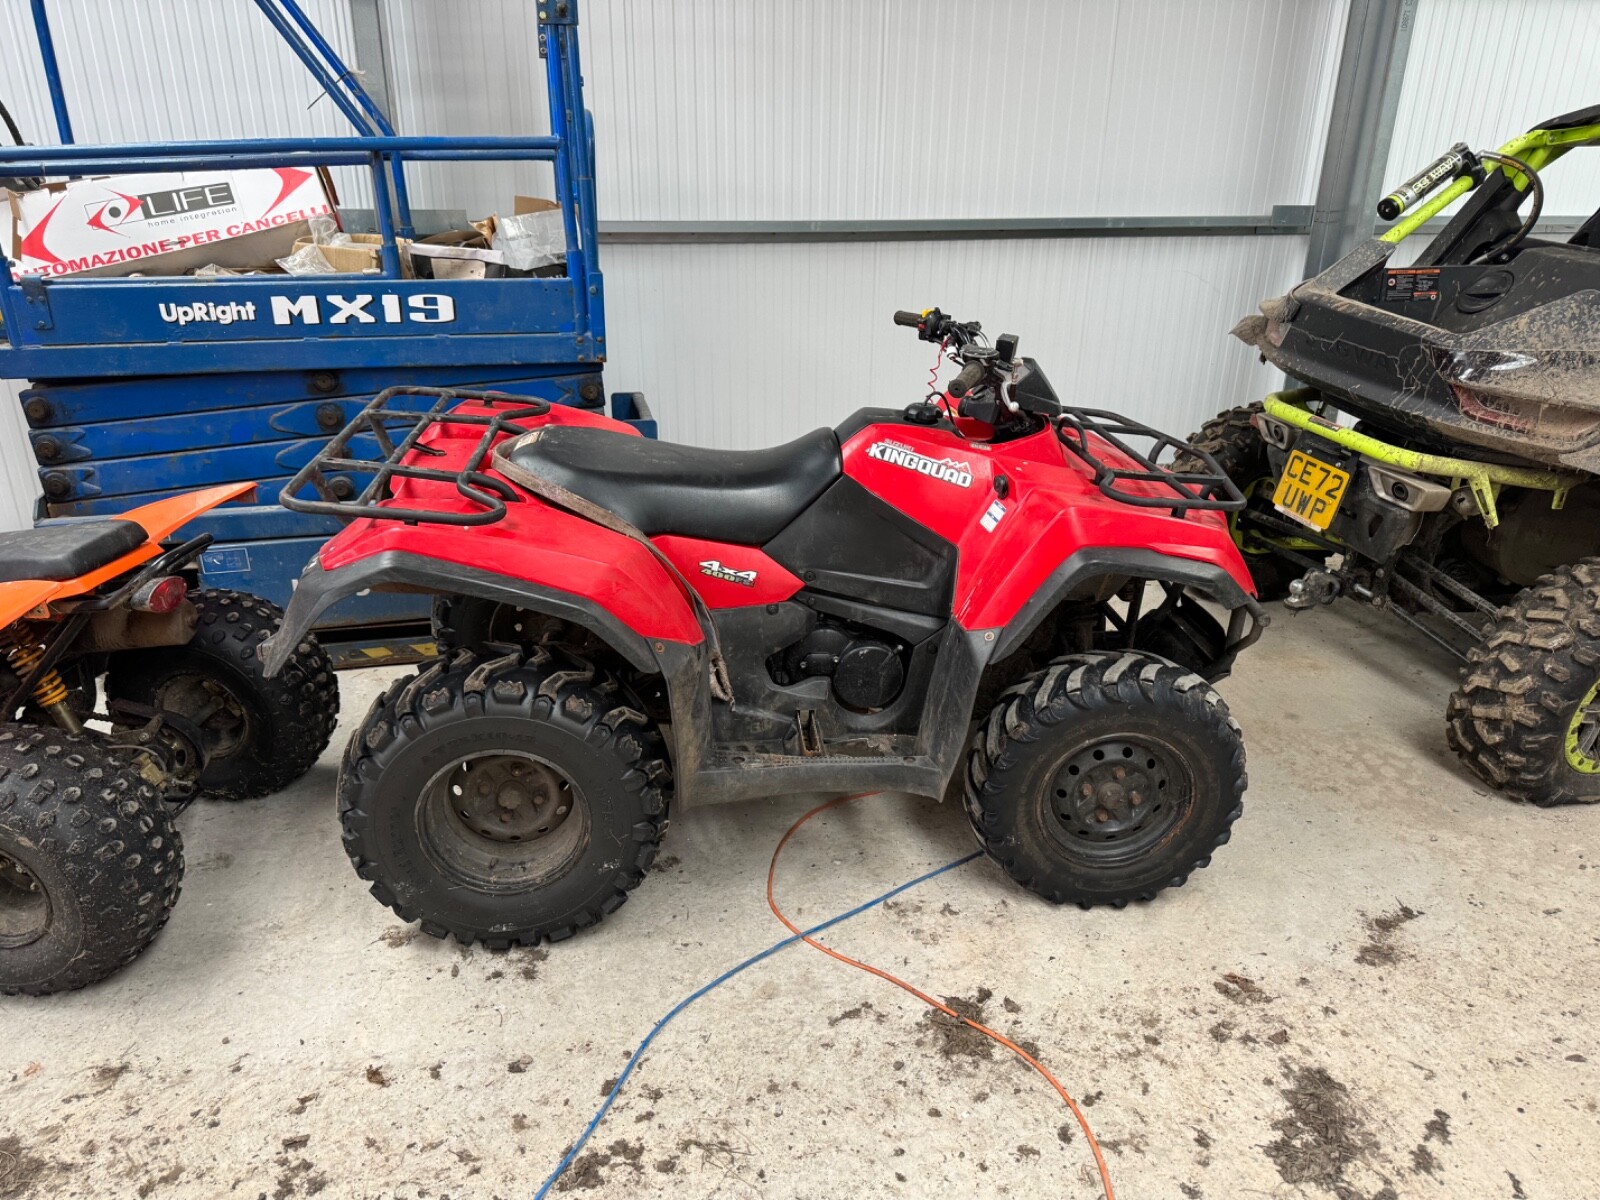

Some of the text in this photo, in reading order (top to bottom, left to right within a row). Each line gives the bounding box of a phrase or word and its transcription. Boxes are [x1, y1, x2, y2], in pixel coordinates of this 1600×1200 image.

[146, 184, 233, 216] LIFE
[147, 206, 238, 229] home integration
[12, 205, 330, 281] ATOMAZIONE PER CANCELLI
[158, 294, 455, 326] UpRight MX19
[1287, 455, 1344, 500] CE72
[1282, 484, 1327, 519] UWP
